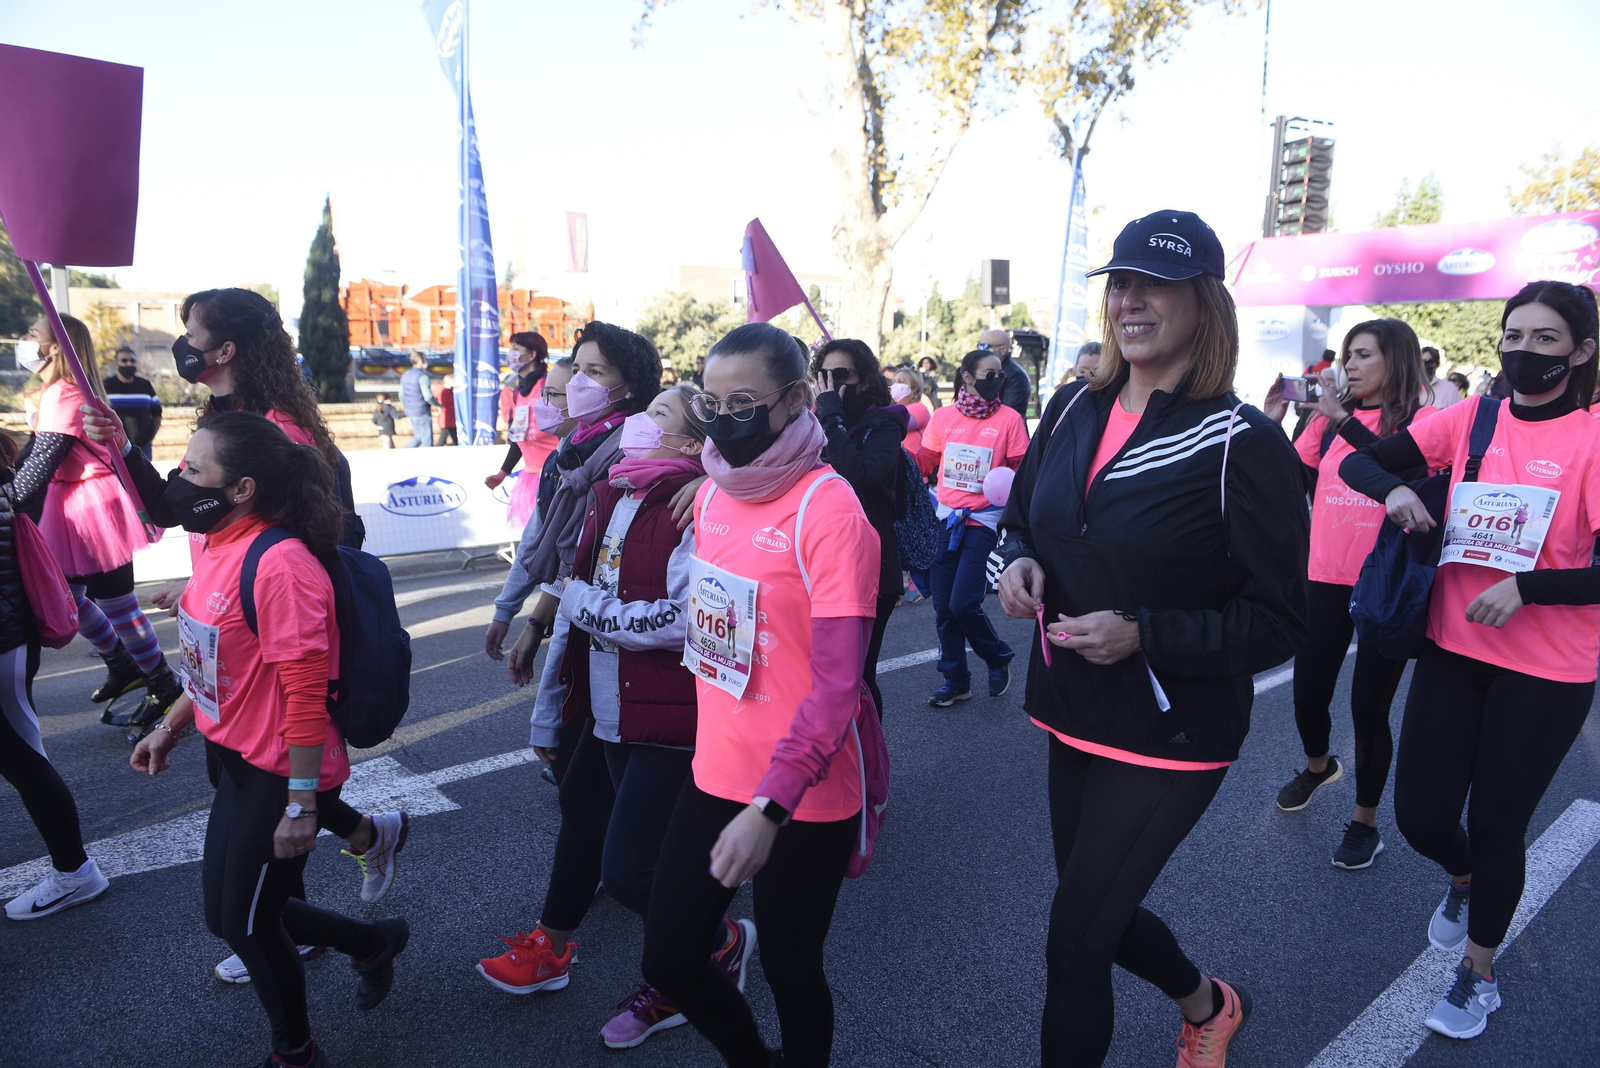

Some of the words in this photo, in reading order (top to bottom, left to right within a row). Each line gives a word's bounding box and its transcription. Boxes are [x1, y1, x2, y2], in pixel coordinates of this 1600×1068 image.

[1148, 237, 1193, 257] SYRSA
[1318, 266, 1359, 278] ZURICH
[1373, 261, 1425, 276] OYSHO
[1542, 365, 1566, 381] SYRSA
[955, 461, 975, 472] 016
[192, 499, 220, 514] SYRSA
[388, 492, 461, 508] ASTURIANA
[1325, 496, 1380, 508] NOSOTRAS
[1476, 498, 1518, 508] ASTURIANA
[1468, 514, 1512, 531] 016
[1471, 532, 1494, 541] 4641
[1494, 543, 1518, 553] MUJER
[1504, 559, 1526, 568] ZURICH
[698, 584, 728, 606] ASTURIANA
[576, 607, 621, 633] TUNES
[624, 603, 682, 634] LOONEY
[697, 608, 726, 639] 016
[700, 636, 717, 651] 4629
[703, 649, 711, 658] DE
[710, 652, 718, 661] LA
[717, 656, 737, 669] MUJER
[755, 693, 771, 702] 2021
